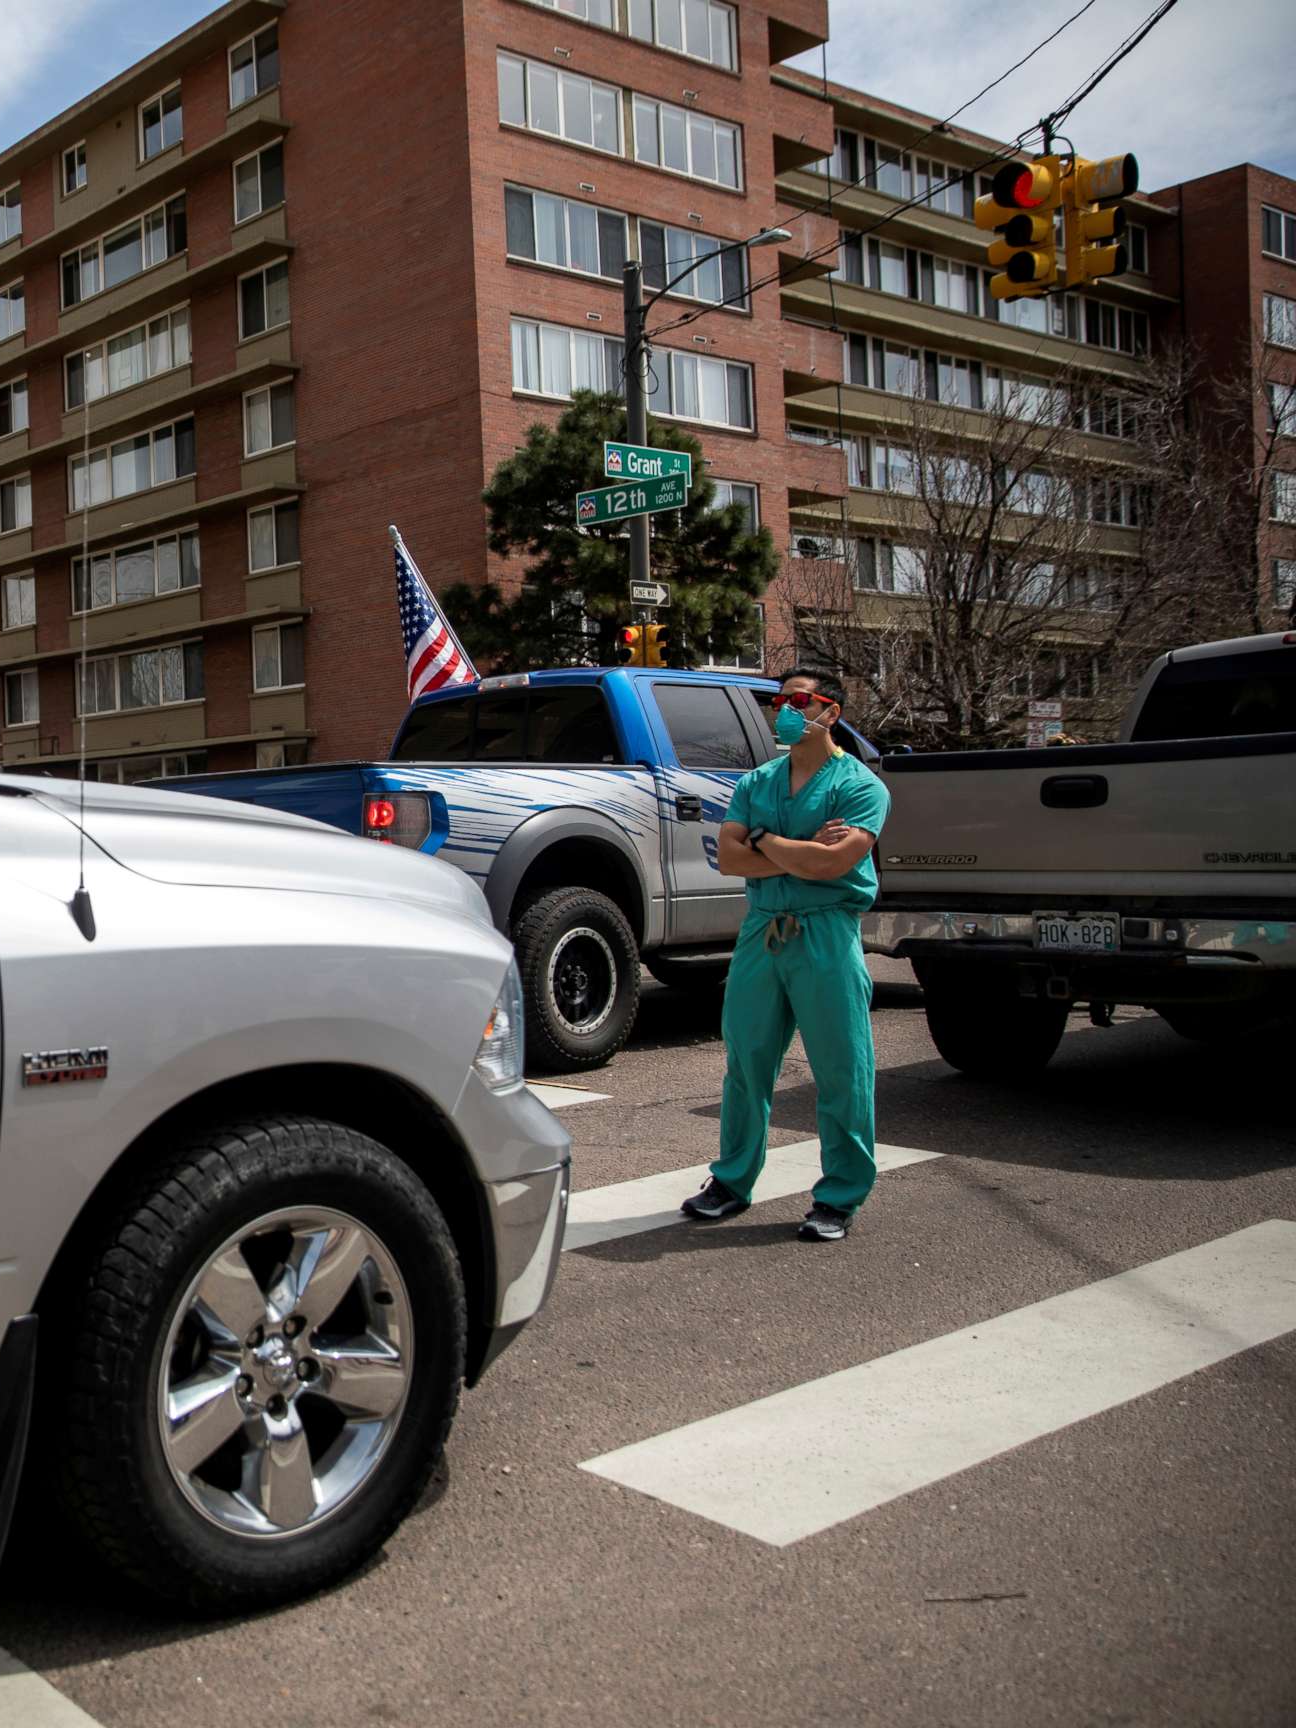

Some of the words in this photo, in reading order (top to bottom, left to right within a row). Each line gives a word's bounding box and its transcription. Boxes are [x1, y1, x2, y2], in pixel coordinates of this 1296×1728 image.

[628, 452, 663, 477] Grant
[605, 488, 646, 514] 12th
[661, 481, 676, 492] AVE
[655, 494, 674, 504] 1200
[676, 491, 683, 500] N
[635, 587, 646, 597] ONE
[647, 589, 658, 598] WAY
[902, 855, 977, 865] SILVERADO
[21, 1046, 109, 1073] HEMI
